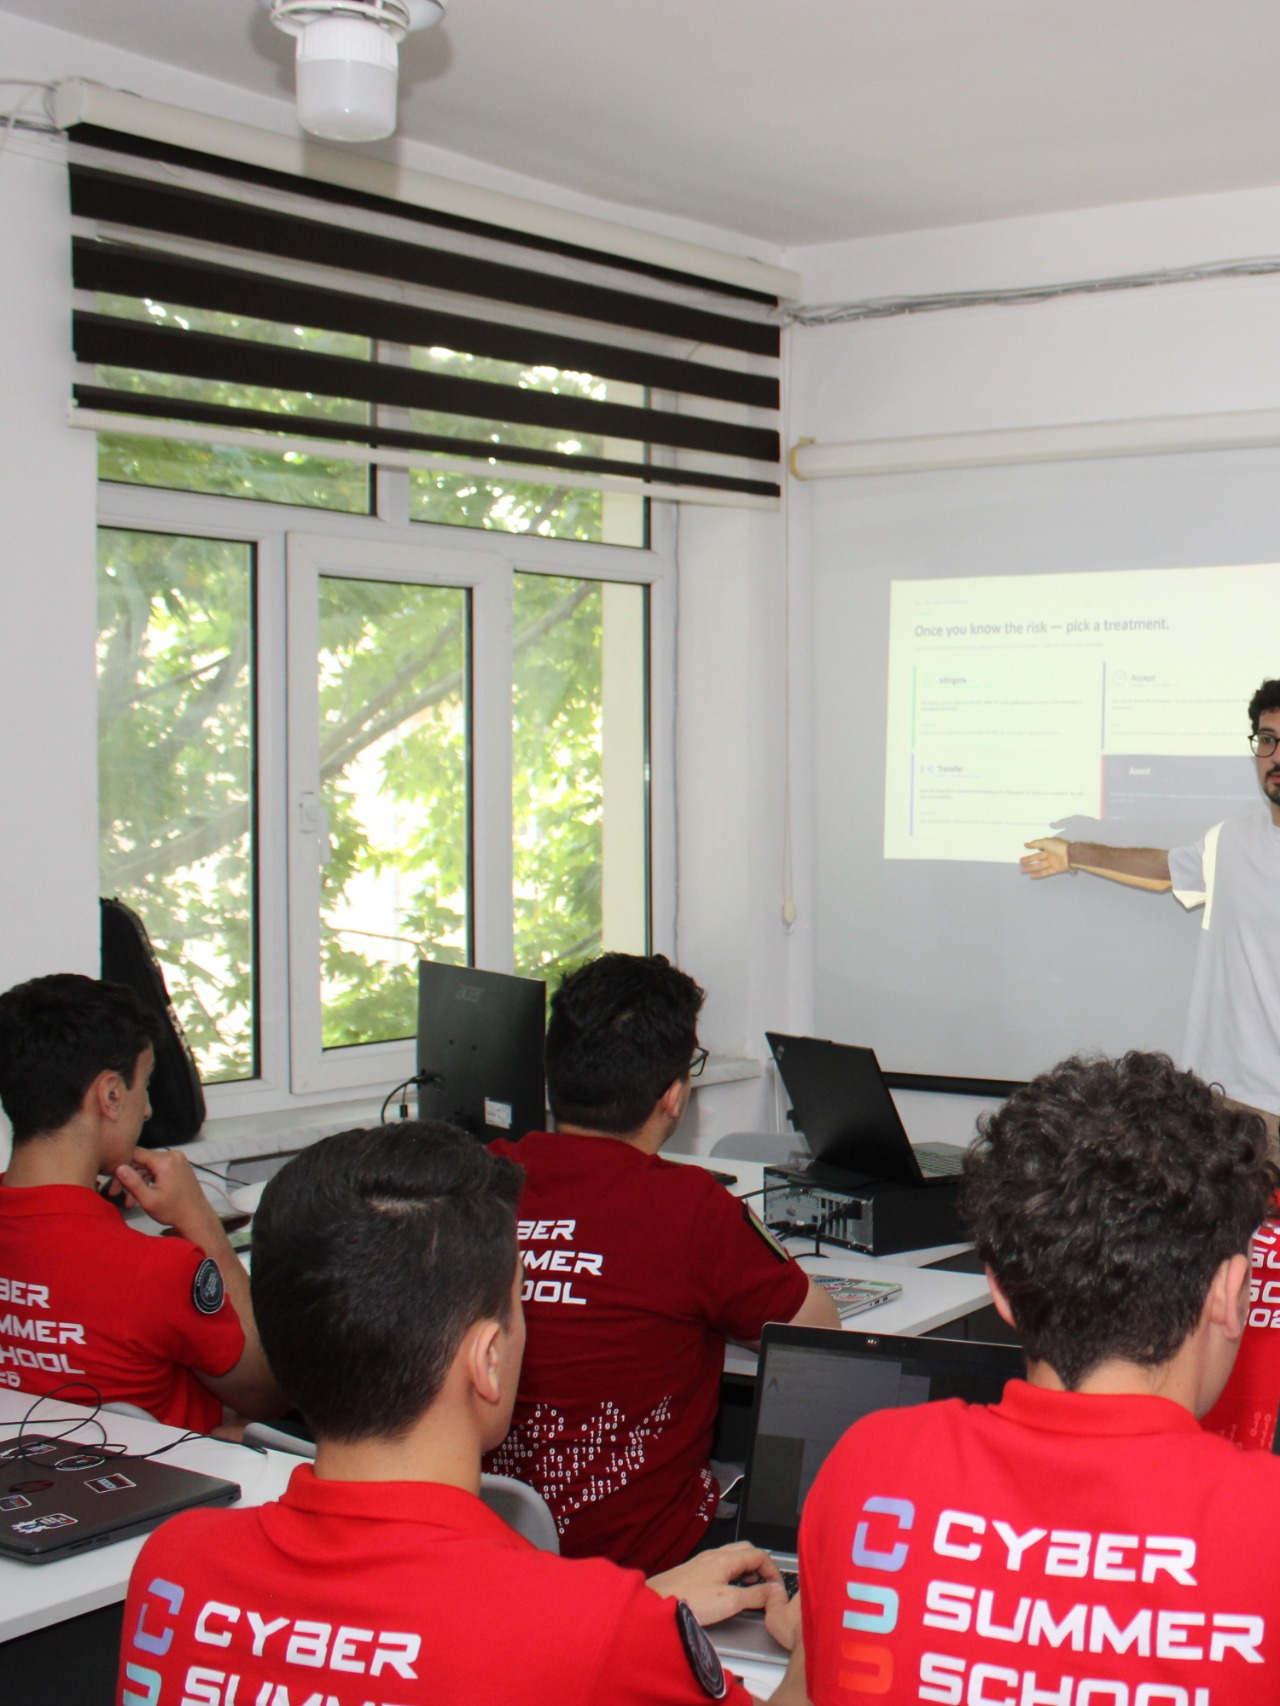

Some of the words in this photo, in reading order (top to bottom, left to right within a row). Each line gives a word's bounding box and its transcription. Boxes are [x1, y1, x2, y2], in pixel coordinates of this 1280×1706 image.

[914, 624, 943, 637] Once
[946, 625, 967, 638] you
[970, 621, 1001, 635] know
[1004, 621, 1024, 634] the
[1026, 620, 1048, 633] risk
[1066, 618, 1091, 635] pick
[1093, 621, 1100, 631] a
[1103, 618, 1170, 632] treatment.
[517, 1219, 577, 1241] BER
[0, 1277, 51, 1309] BER
[932, 1508, 1198, 1587] CYBER
[194, 1600, 423, 1680] CYBER
[922, 1579, 1266, 1664] SUMMER
